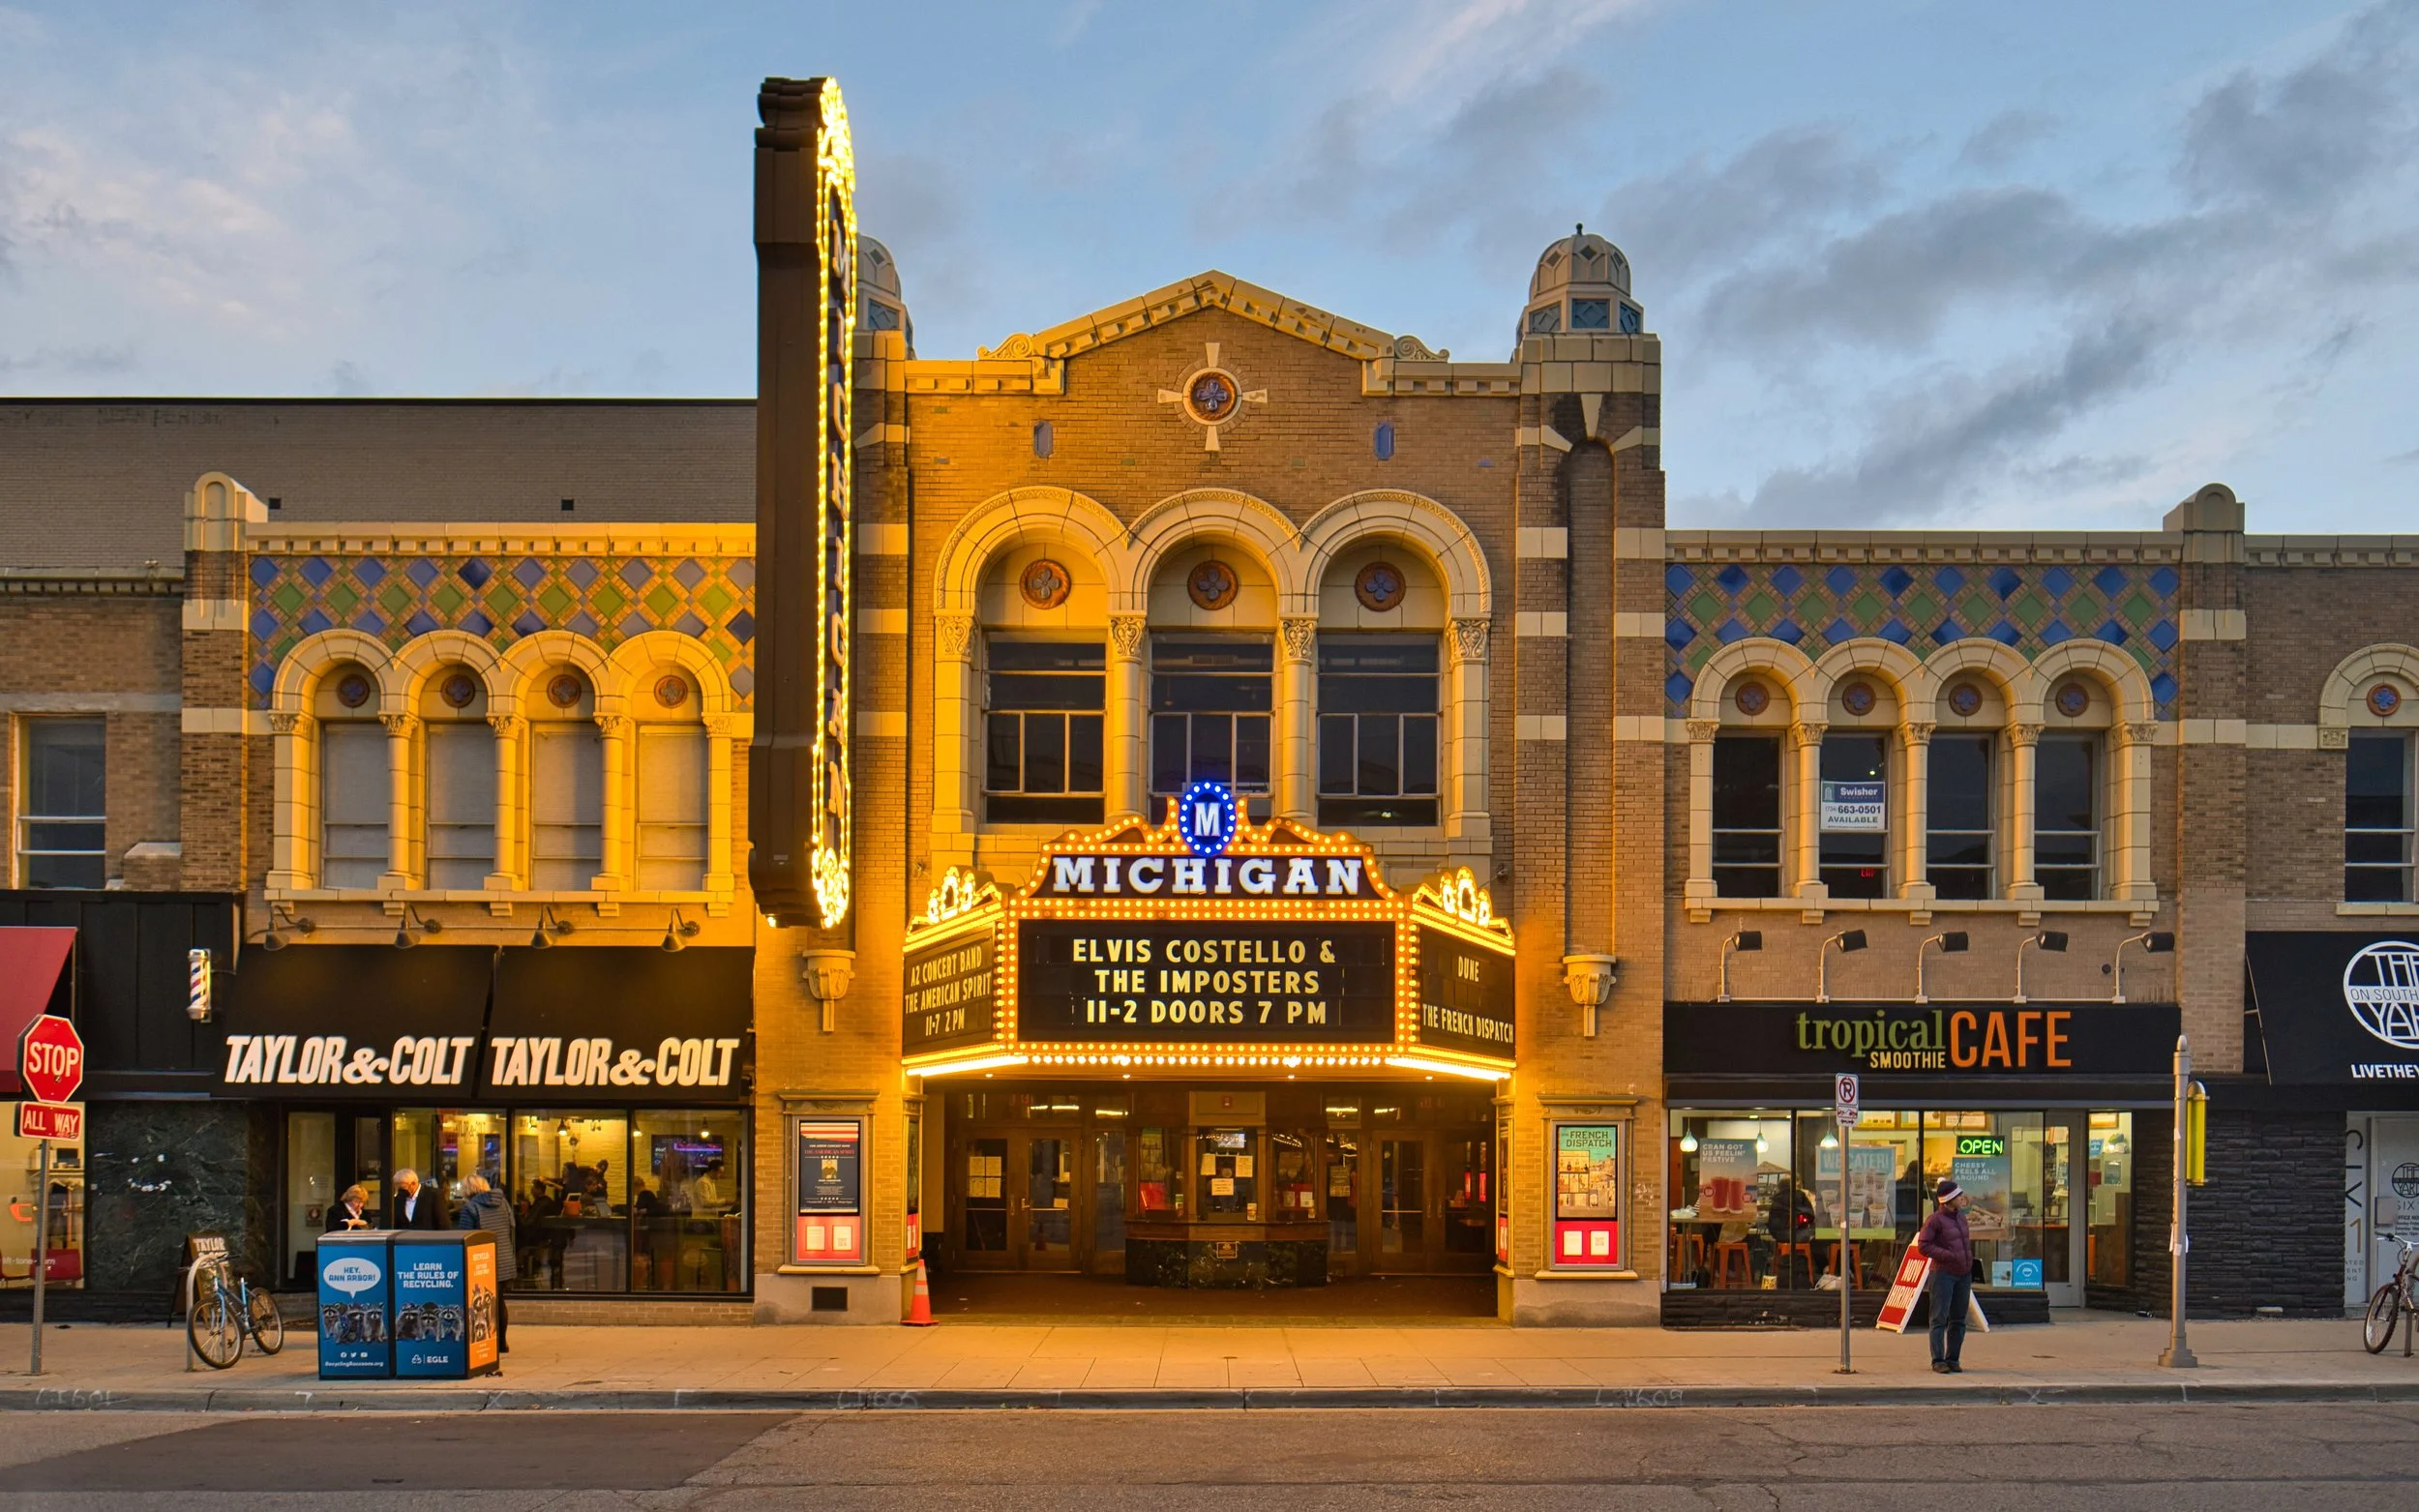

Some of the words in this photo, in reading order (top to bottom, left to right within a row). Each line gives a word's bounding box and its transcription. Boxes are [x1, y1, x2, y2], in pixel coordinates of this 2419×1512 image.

[1840, 786, 1878, 797] Swisher
[1195, 802, 1220, 837] M
[1838, 805, 1881, 815] 663-0501
[1053, 857, 1361, 895] MICHIGAN
[1073, 939, 1151, 964] ELVIS
[1166, 940, 1306, 964] COSTELLO
[1319, 940, 1335, 964] &
[911, 965, 920, 987] A2
[922, 954, 958, 984] CONCERT
[960, 946, 982, 973] BAND
[1458, 956, 1479, 983] DUNE
[905, 993, 918, 1015] THE
[920, 981, 960, 1011] AMERICAN
[963, 971, 992, 1000] SPIRIT
[1094, 969, 1146, 993] THE
[1160, 970, 1320, 994] IMPOSTERS
[2350, 989, 2370, 1001] ON
[925, 1014, 941, 1036] 11-7
[945, 1012, 950, 1032] 2
[952, 1008, 965, 1031] PM
[1087, 1000, 1138, 1023] 11-2
[1151, 1001, 1244, 1024] DOORS
[1257, 1002, 1273, 1024] 7
[1287, 1002, 1328, 1024] PM
[1422, 1003, 1439, 1028] THE
[1441, 1008, 1474, 1036] FRENCH
[1477, 1017, 1513, 1044] DISPATCH
[1796, 1010, 1946, 1057] tropical
[1951, 1011, 2072, 1068] CAFE
[28, 1042, 79, 1077] STOP
[1870, 1052, 1946, 1069] SMOOTHIE
[24, 1111, 46, 1131] ALL
[54, 1113, 78, 1134] WAY
[1569, 1131, 1609, 1140] FRENCH
[1959, 1139, 2004, 1154] OPEN
[194, 1237, 226, 1252] TAYLOR
[398, 1271, 414, 1280] THE
[417, 1271, 445, 1280] RULES
[447, 1271, 459, 1280] OF
[413, 1262, 442, 1271] LEARN
[1900, 1259, 1926, 1284] NOW
[403, 1280, 454, 1289] RECYCLING.
